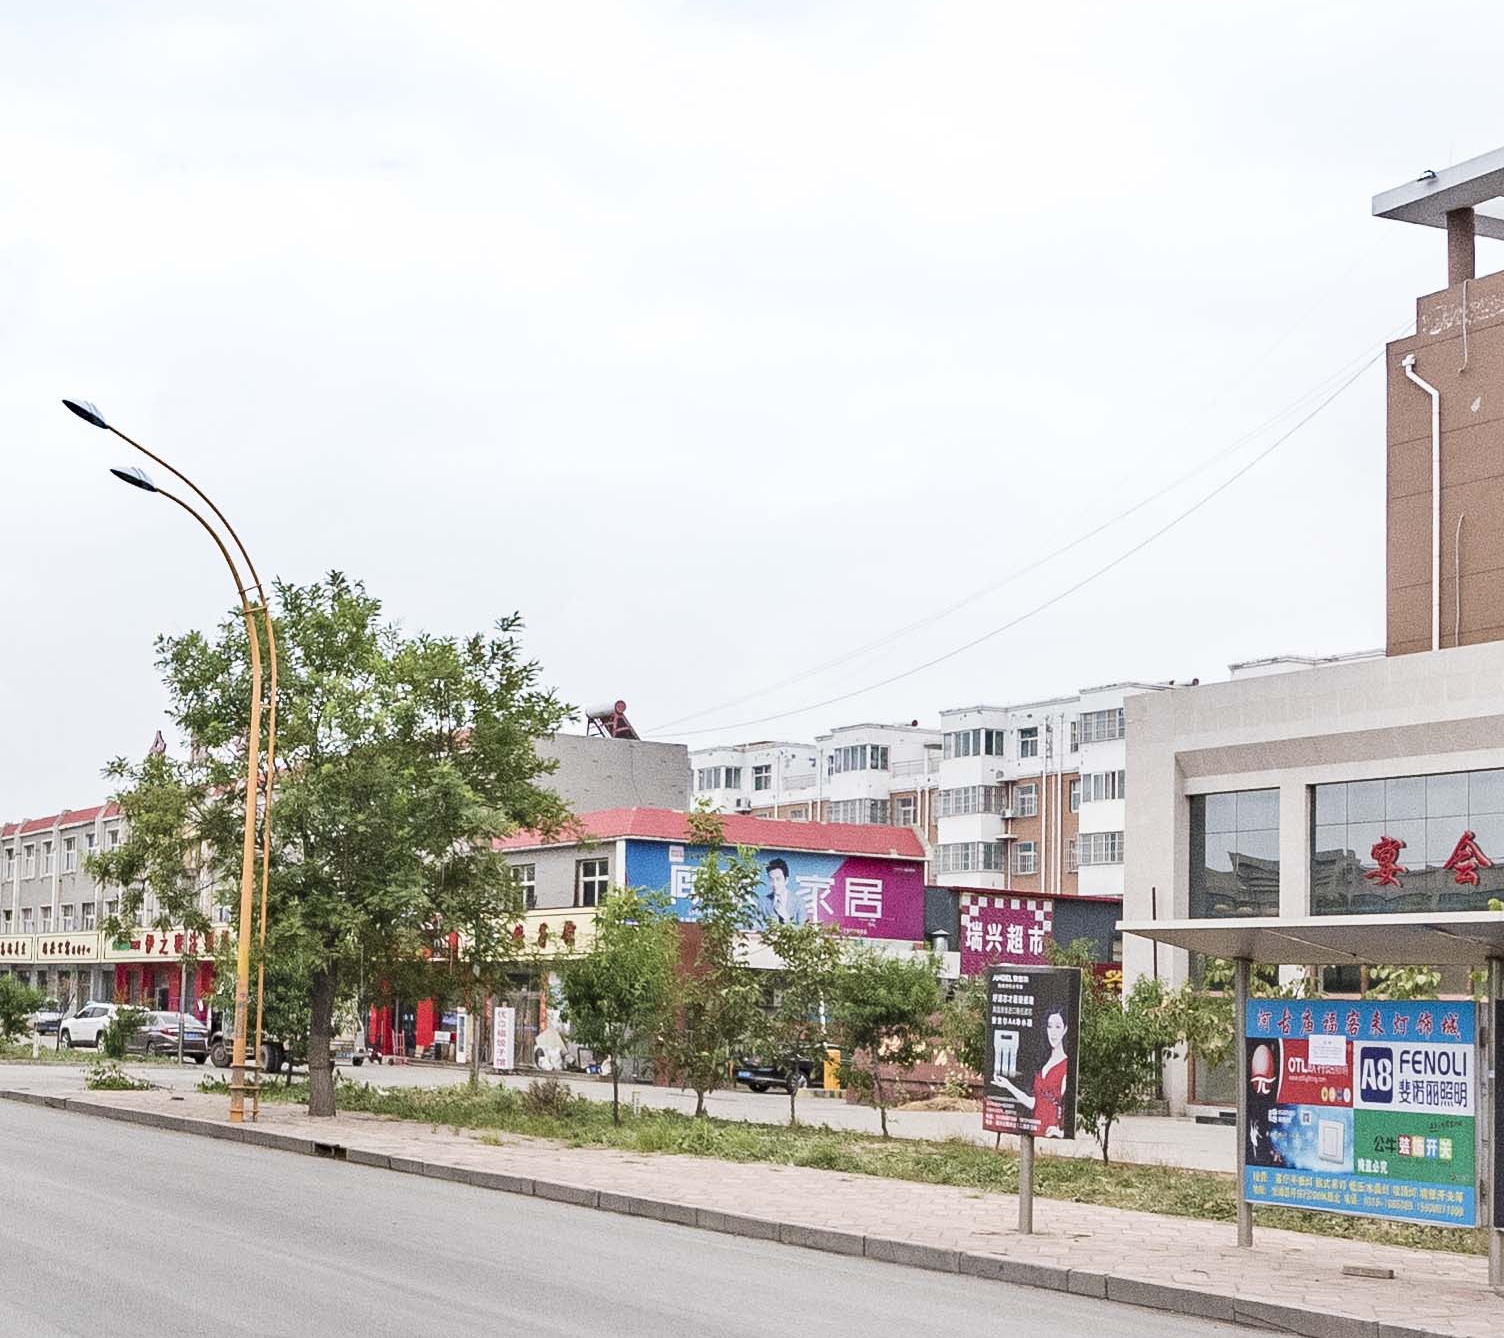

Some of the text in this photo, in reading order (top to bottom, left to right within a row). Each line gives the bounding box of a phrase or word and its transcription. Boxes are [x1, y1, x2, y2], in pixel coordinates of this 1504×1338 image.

[966, 920, 1044, 956] 瑞兴超市
[1361, 1058, 1392, 1092] A8
[1399, 1049, 1467, 1077] FENOLI
[1399, 1079, 1468, 1107] 斐诺丽照明
